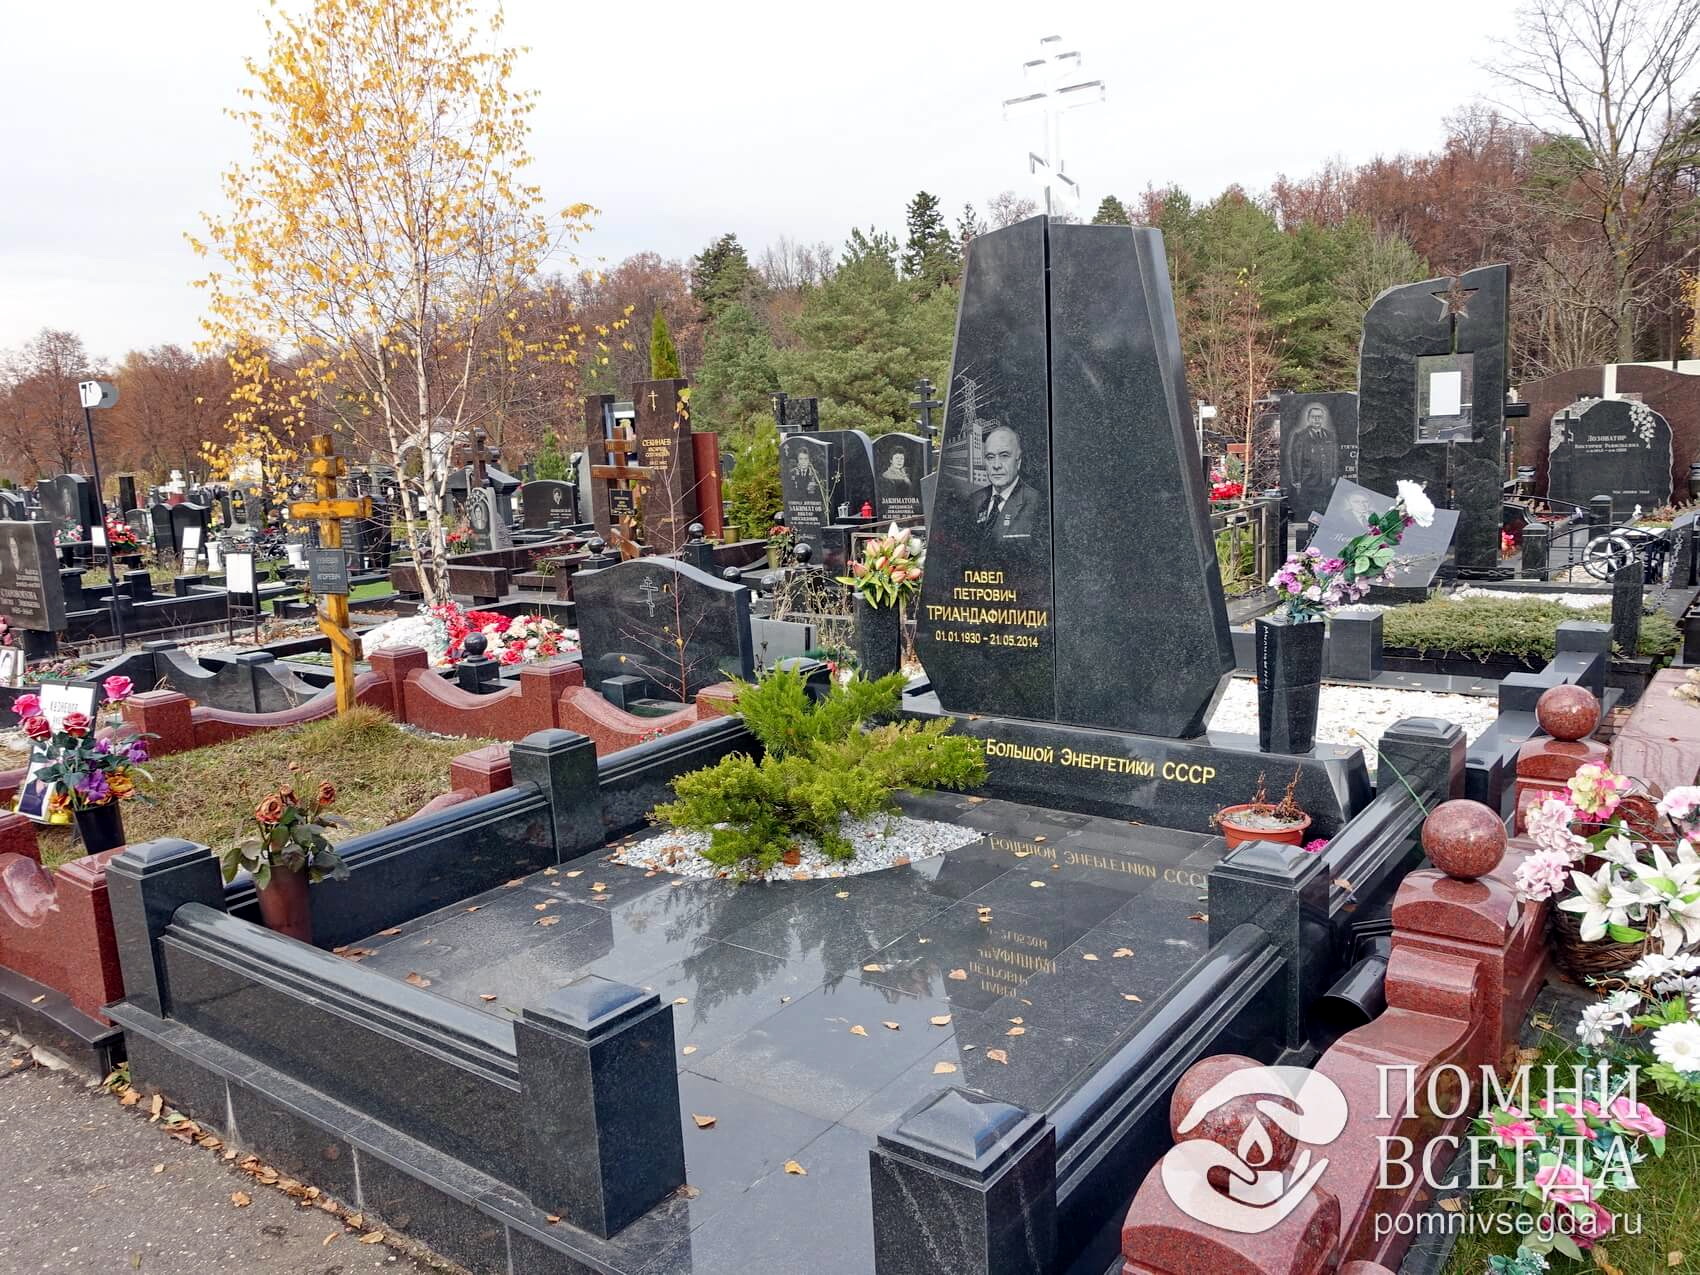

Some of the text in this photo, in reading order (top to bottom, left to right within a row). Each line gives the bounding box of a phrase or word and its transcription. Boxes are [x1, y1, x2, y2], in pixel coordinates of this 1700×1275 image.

[964, 570, 1004, 584] ПАВЕЛ
[953, 587, 1017, 602] ПЕТРОВИЧ
[926, 604, 1048, 628] ТРИАНДАФИЛИДИ
[935, 630, 981, 644] 01.01.1930
[990, 633, 1039, 648] 21.05.2014
[1060, 748, 1155, 777] ЭНЕРГЕТИКИ
[1162, 761, 1216, 785] СССР
